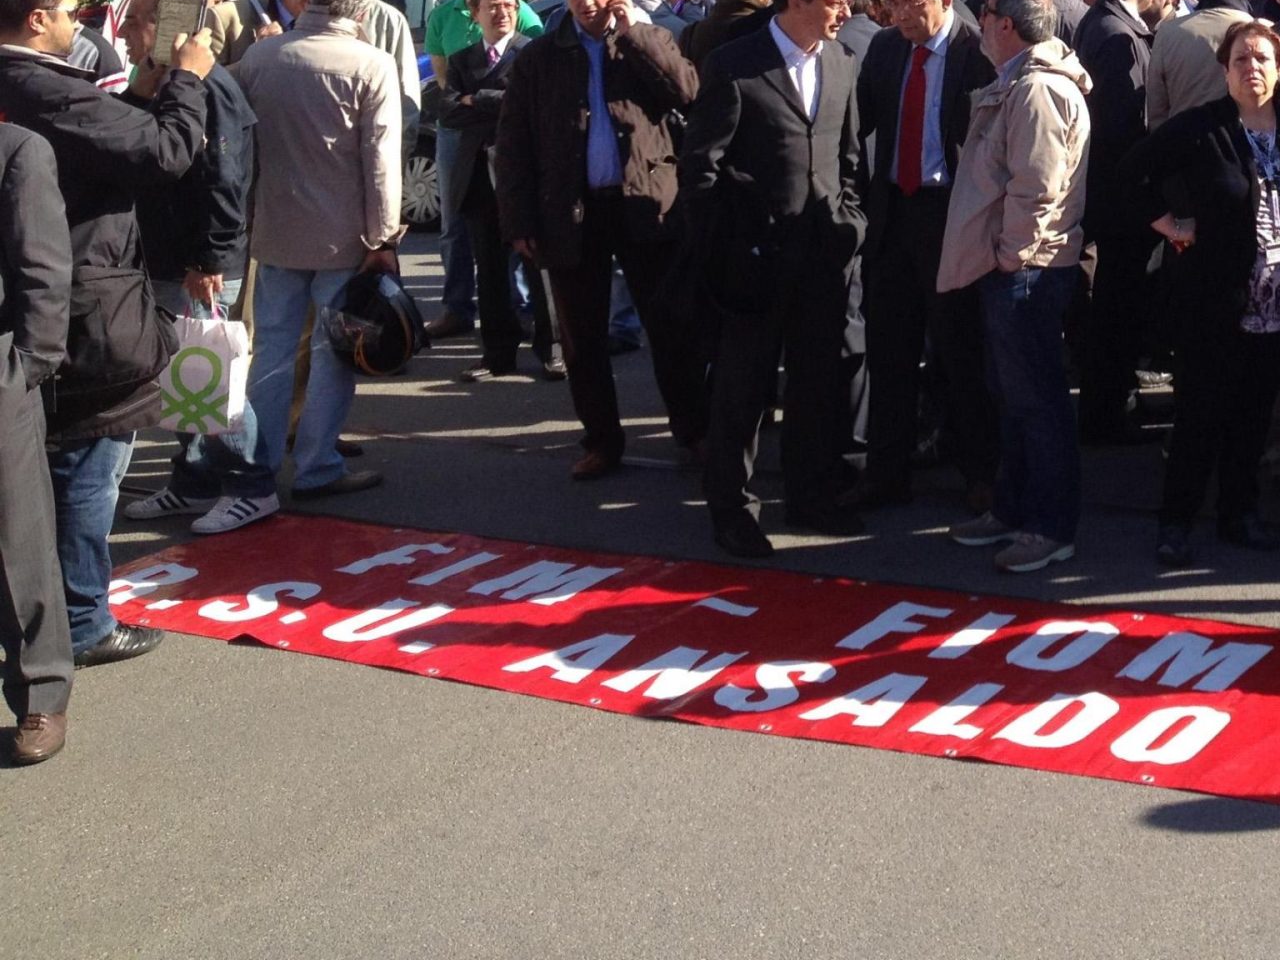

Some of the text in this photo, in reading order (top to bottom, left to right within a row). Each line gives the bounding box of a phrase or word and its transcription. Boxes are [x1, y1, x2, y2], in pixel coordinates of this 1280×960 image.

[335, 543, 623, 606] FIM
[835, 601, 1274, 692] FIOM
[501, 632, 1232, 765] ANSALDO
